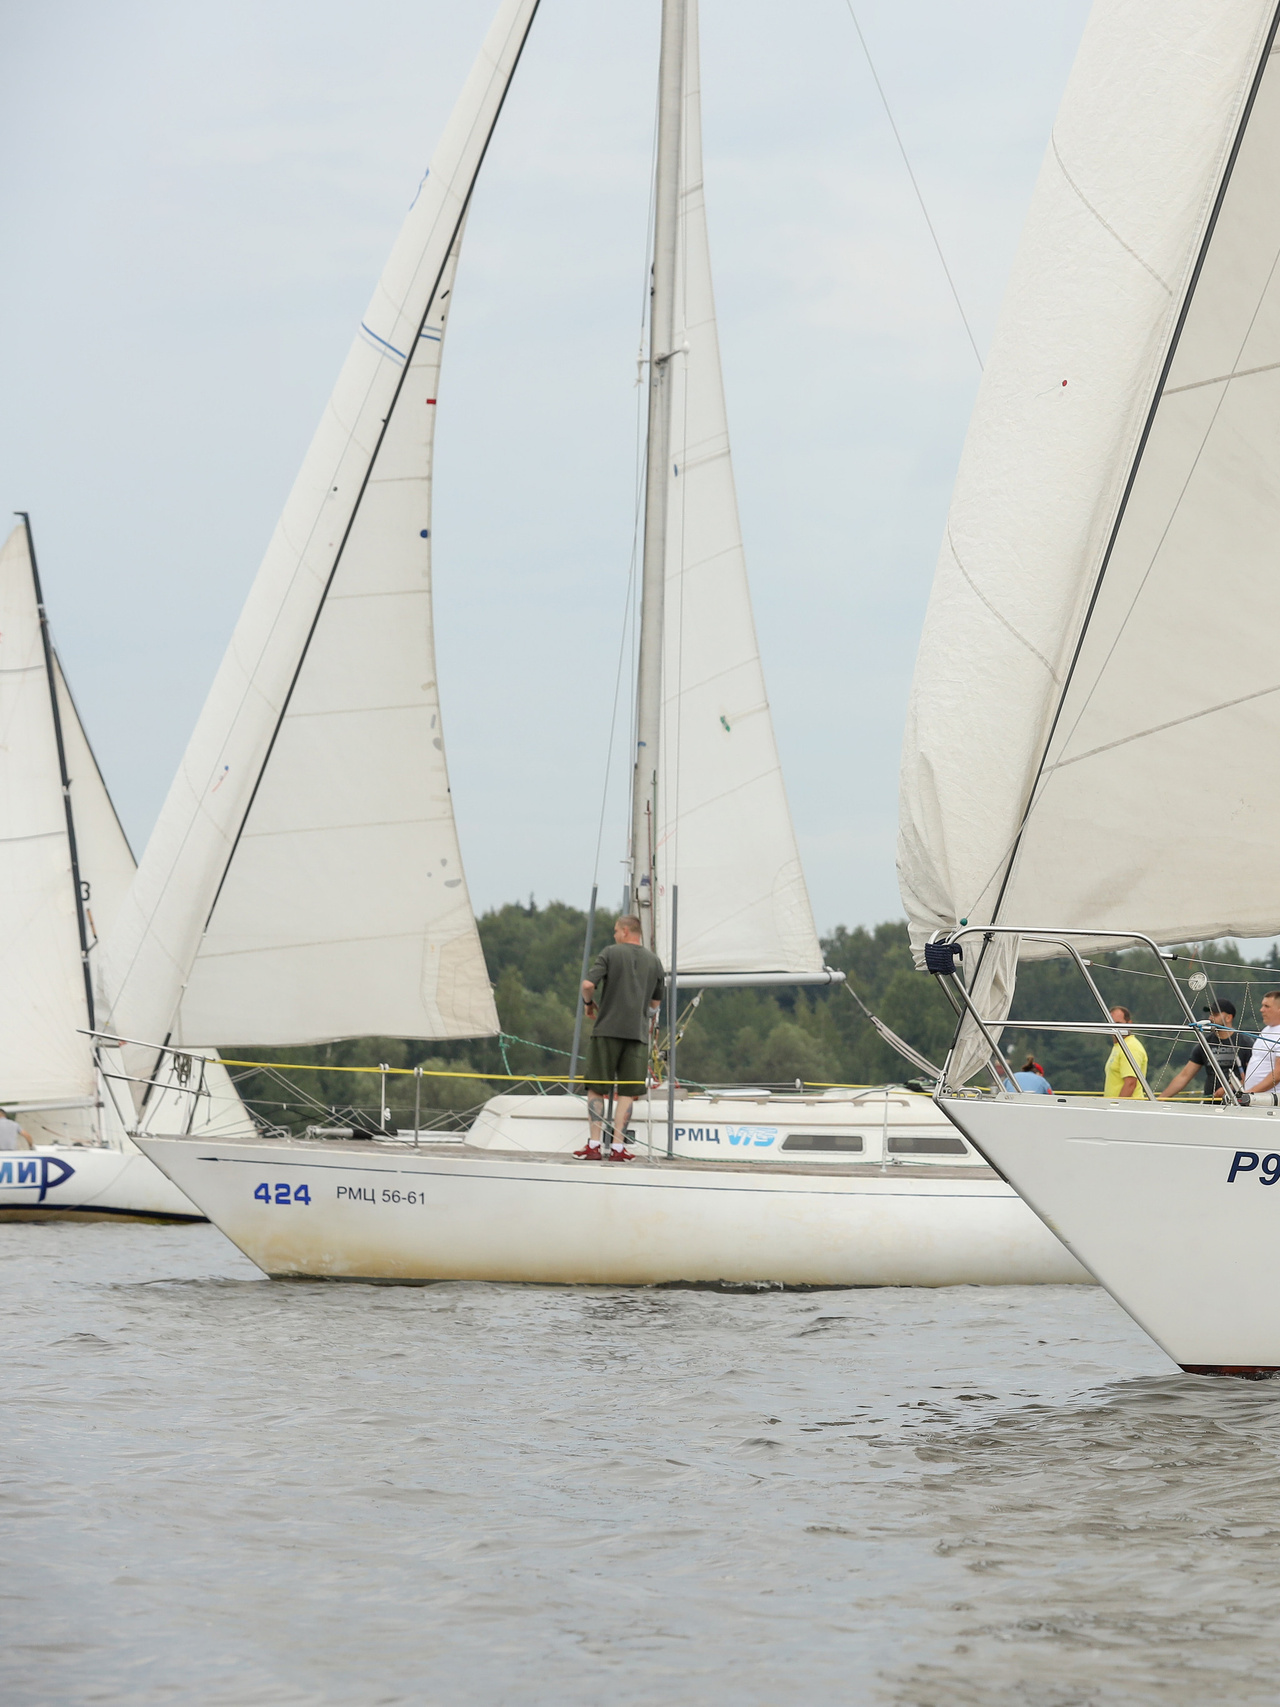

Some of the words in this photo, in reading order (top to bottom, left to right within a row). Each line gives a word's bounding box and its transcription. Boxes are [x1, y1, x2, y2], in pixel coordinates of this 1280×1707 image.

[674, 1127, 720, 1144] РМЦ
[253, 1182, 312, 1206] 424
[336, 1186, 376, 1205] РМЦ
[381, 1189, 426, 1205] 56-61
